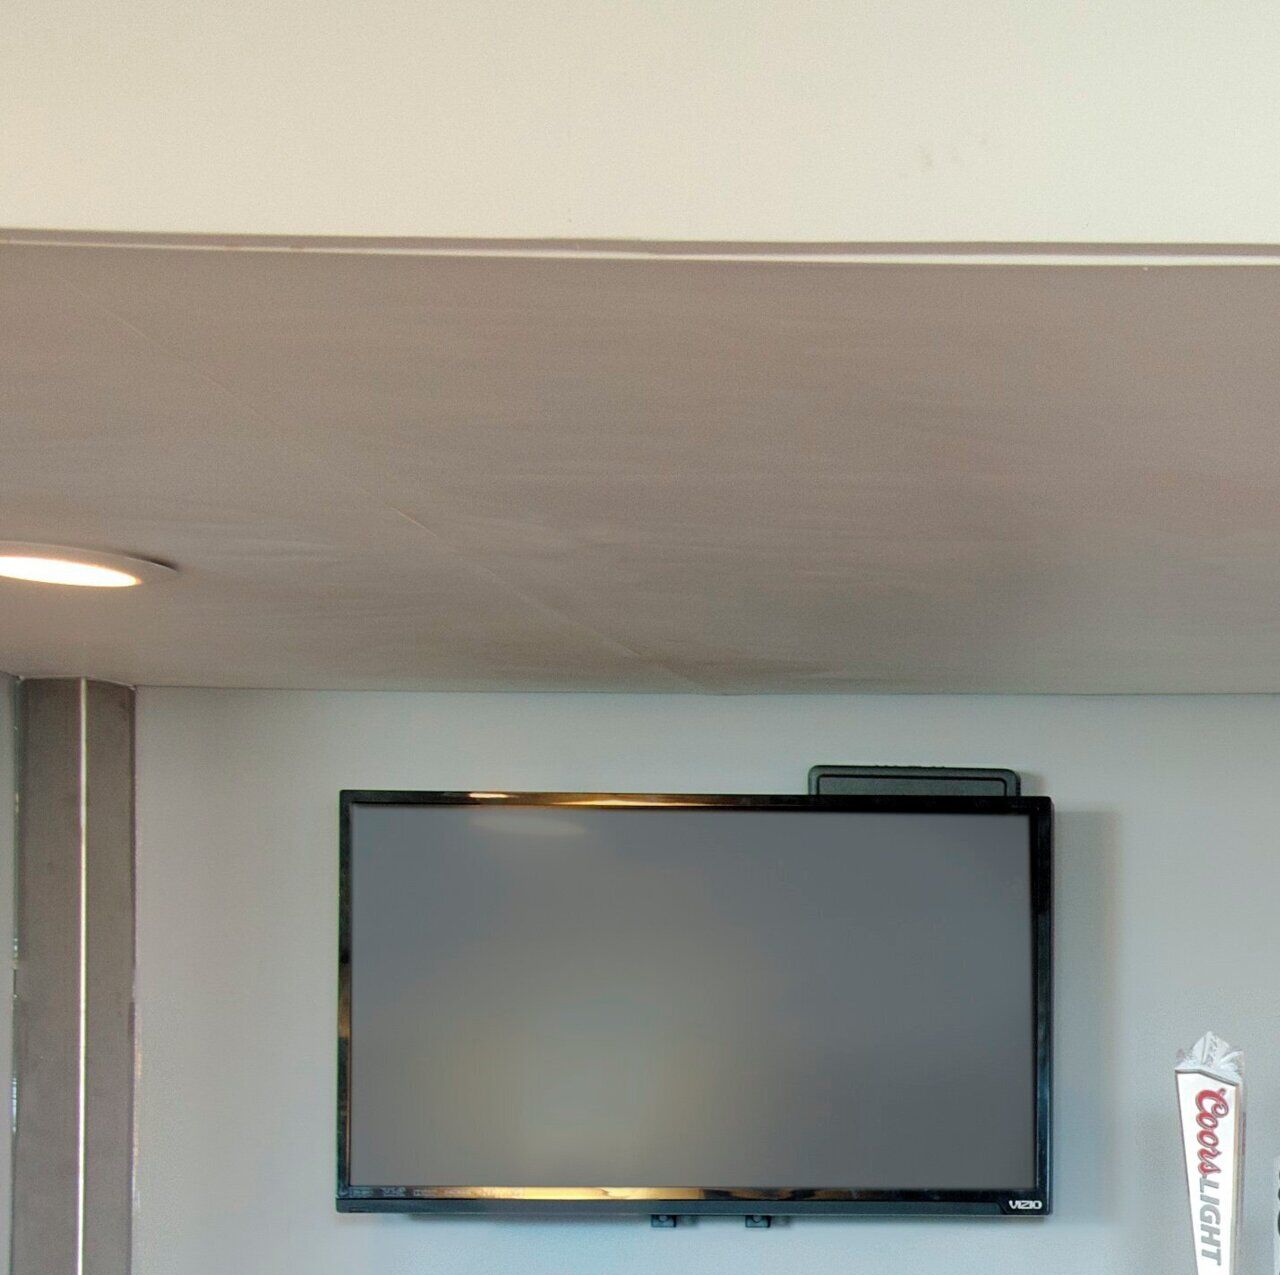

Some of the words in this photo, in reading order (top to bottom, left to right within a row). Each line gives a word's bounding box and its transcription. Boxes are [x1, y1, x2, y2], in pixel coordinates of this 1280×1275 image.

[1195, 1087, 1229, 1177] Coors
[1008, 1200, 1042, 1209] VIZIO
[1199, 1174, 1222, 1266] LIGHT
